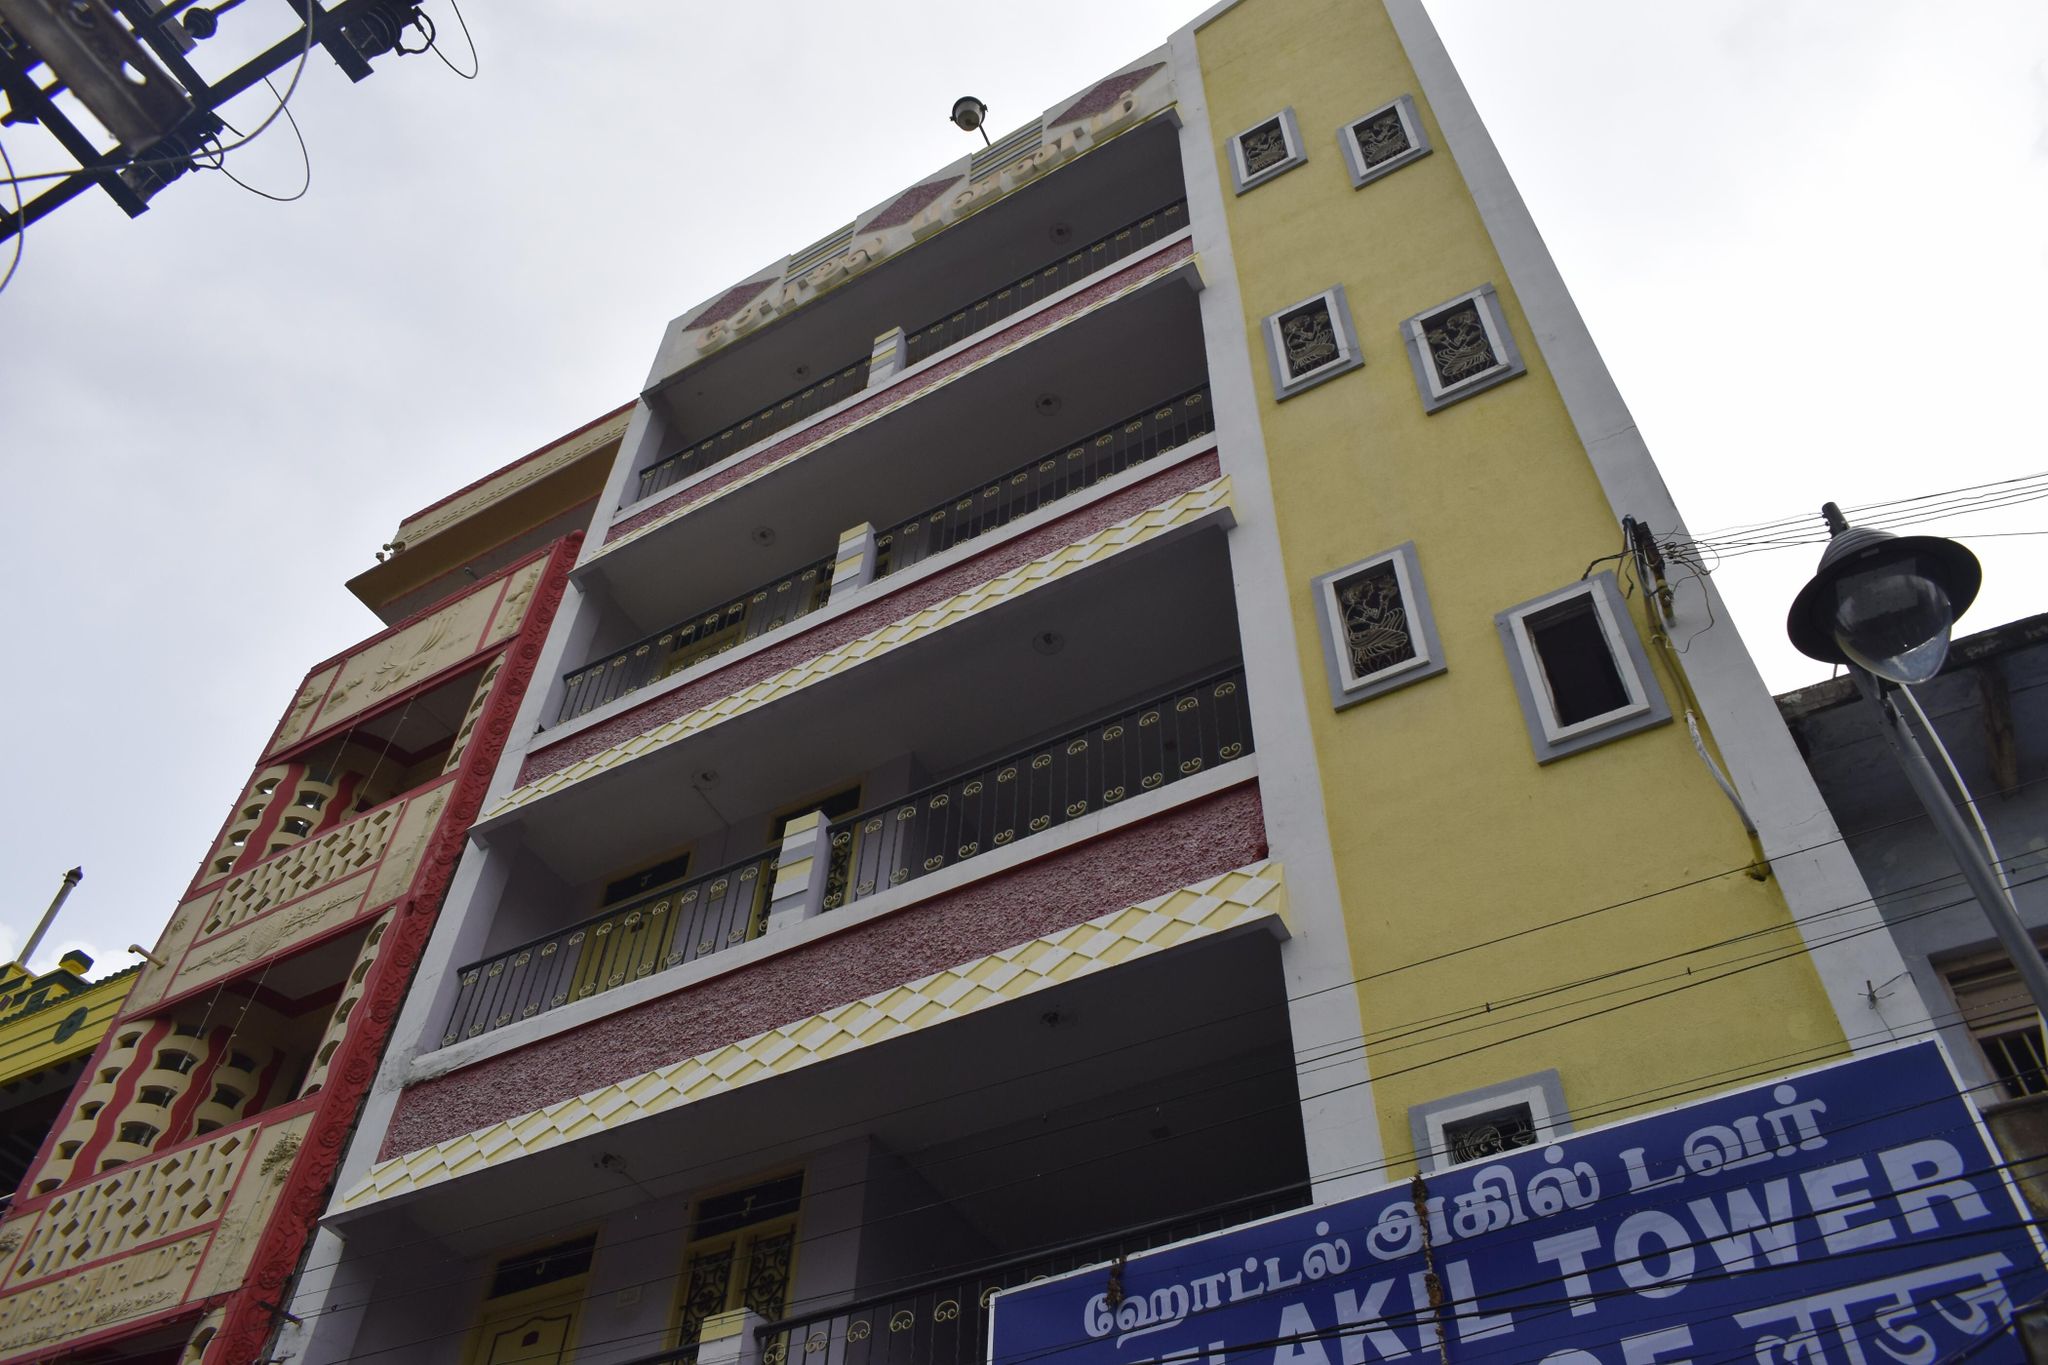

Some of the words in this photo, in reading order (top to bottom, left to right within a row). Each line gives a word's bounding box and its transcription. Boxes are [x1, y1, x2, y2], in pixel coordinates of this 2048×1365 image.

[1083, 1221, 1352, 1348] ஹோட்டல்
[1366, 1146, 1602, 1262] அகில்
[1619, 1085, 1830, 1195] டவர்
[1272, 1259, 1516, 1365] AKIL
[1534, 1138, 1994, 1300] TOWER
